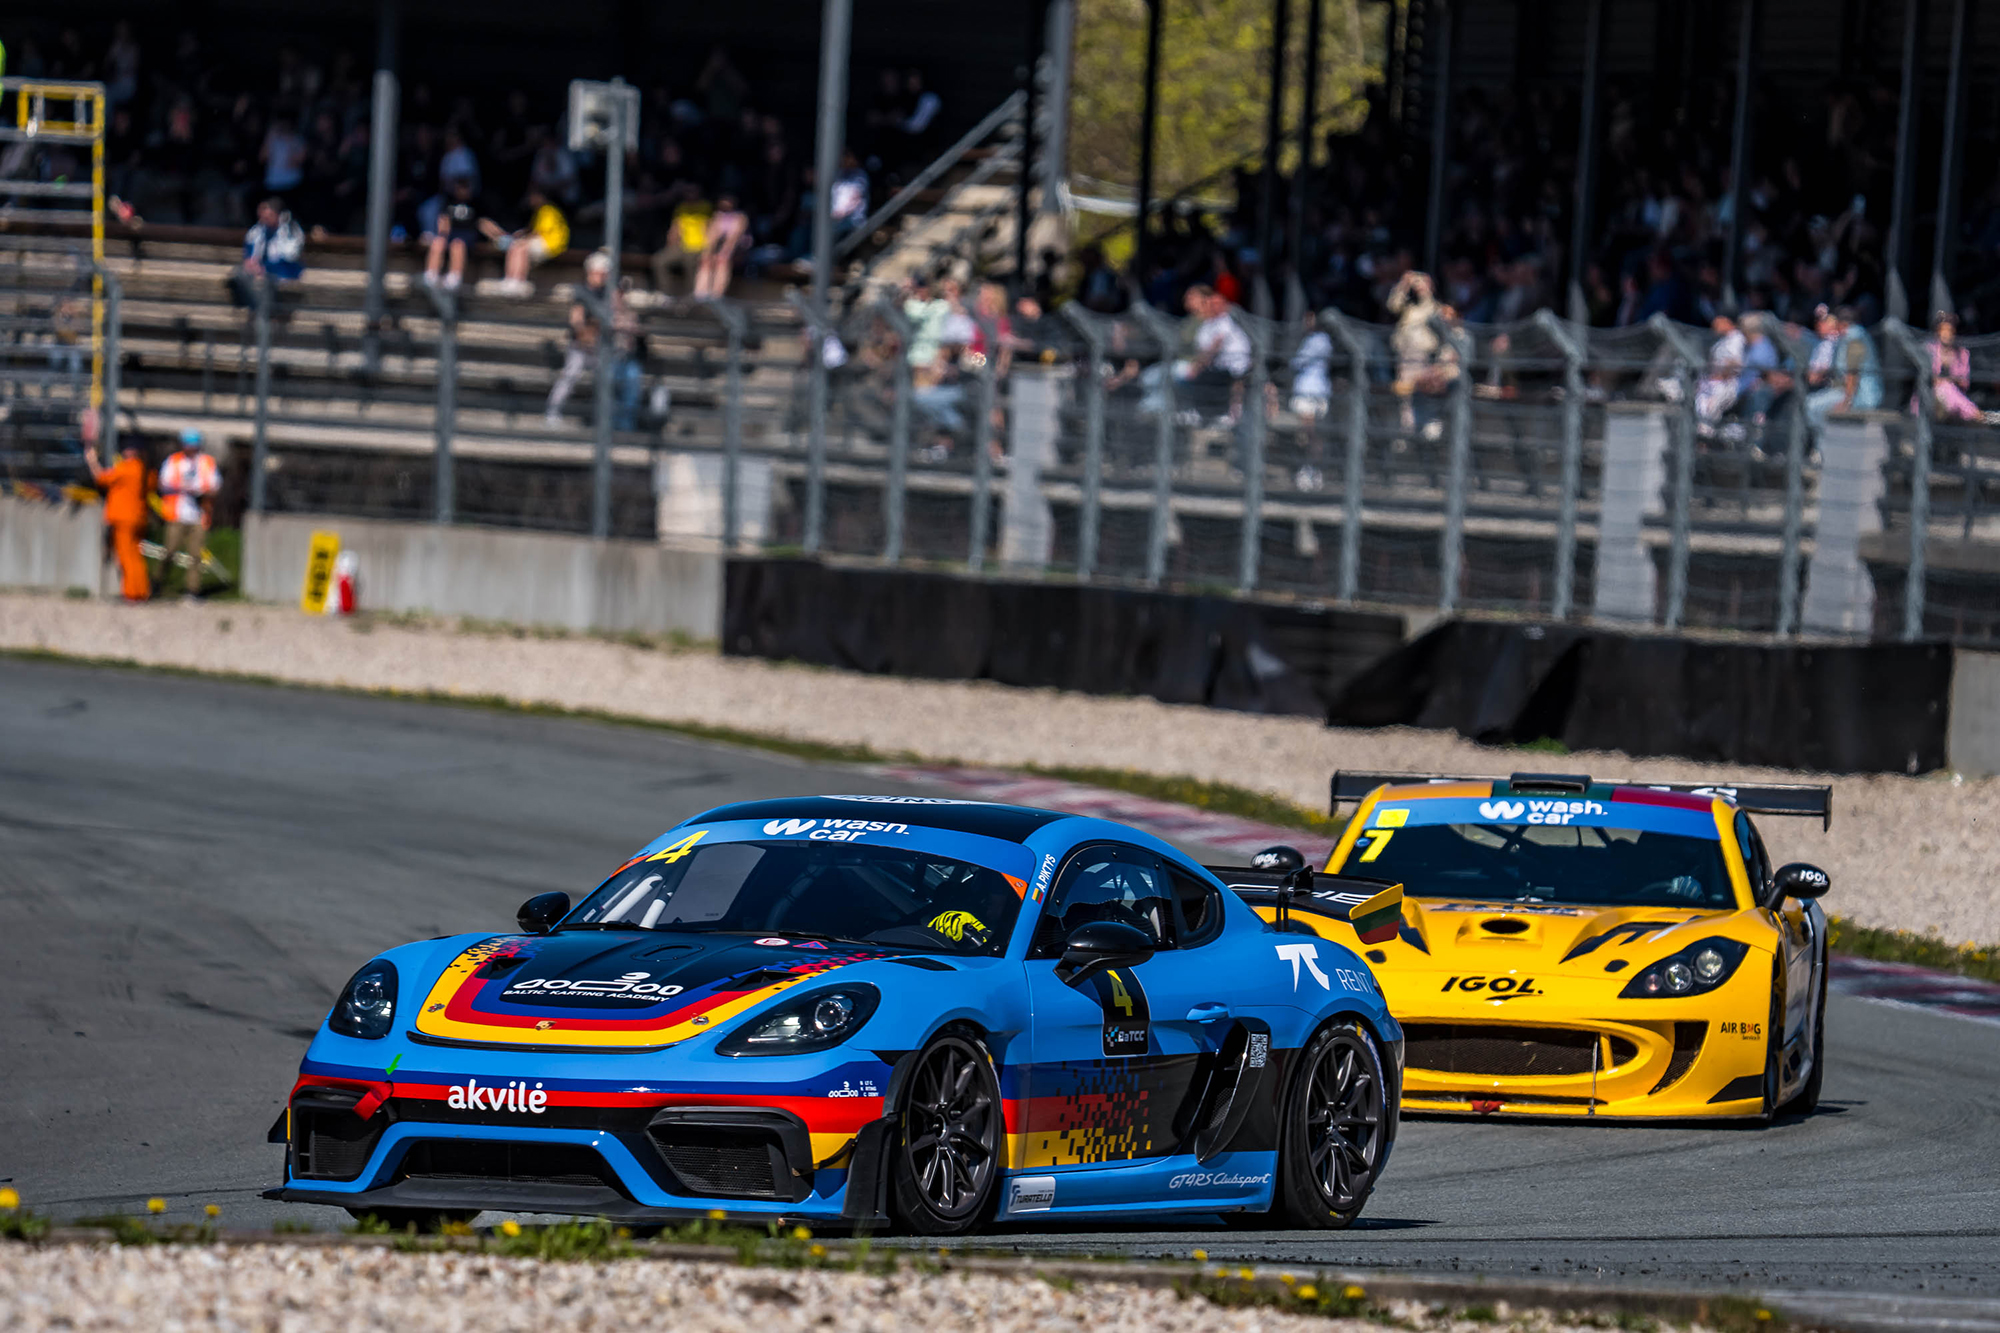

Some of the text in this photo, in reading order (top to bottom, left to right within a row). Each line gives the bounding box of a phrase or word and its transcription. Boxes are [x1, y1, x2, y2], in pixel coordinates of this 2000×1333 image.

[1526, 812, 1575, 825] car
[808, 829, 867, 842] car
[1358, 829, 1395, 863] 7
[645, 830, 709, 864] 4
[1335, 968, 1374, 994] RENT
[548, 990, 606, 998] KARTING
[607, 992, 670, 1002] ACADEMY
[1106, 969, 1134, 1017] 4
[1720, 1021, 1738, 1034] AIR
[447, 1078, 548, 1114] akvilė
[1212, 1172, 1272, 1188] Clubsport
